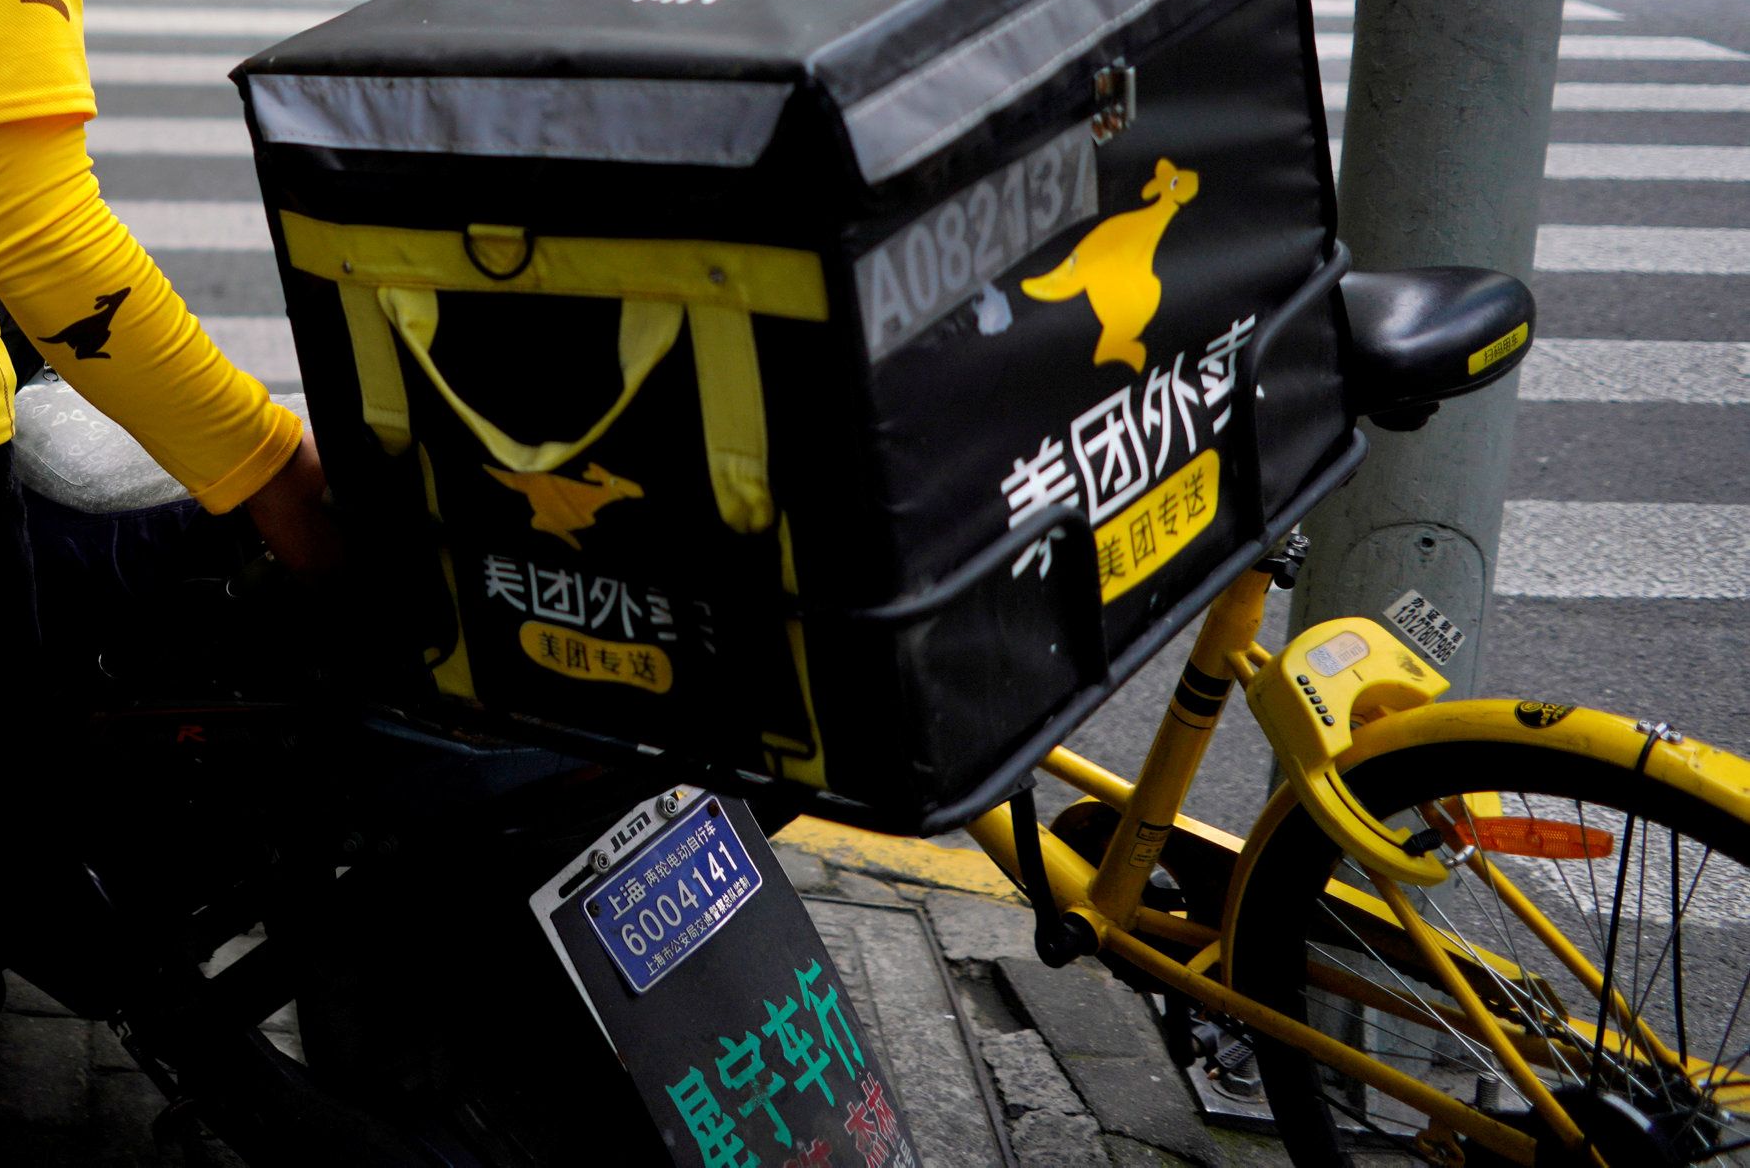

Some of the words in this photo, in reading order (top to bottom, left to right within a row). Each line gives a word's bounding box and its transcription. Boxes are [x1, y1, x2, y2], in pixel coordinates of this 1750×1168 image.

[868, 129, 1093, 348] A082137
[1099, 466, 1208, 586] 美团专送
[539, 630, 657, 683] 美团专送
[1393, 604, 1456, 663] 13127807986
[607, 876, 647, 921] 上海
[643, 820, 717, 888] 两轮电动自行车
[621, 840, 738, 956] 6004141
[645, 874, 752, 977] 上海市公安局交通警察总队监制
